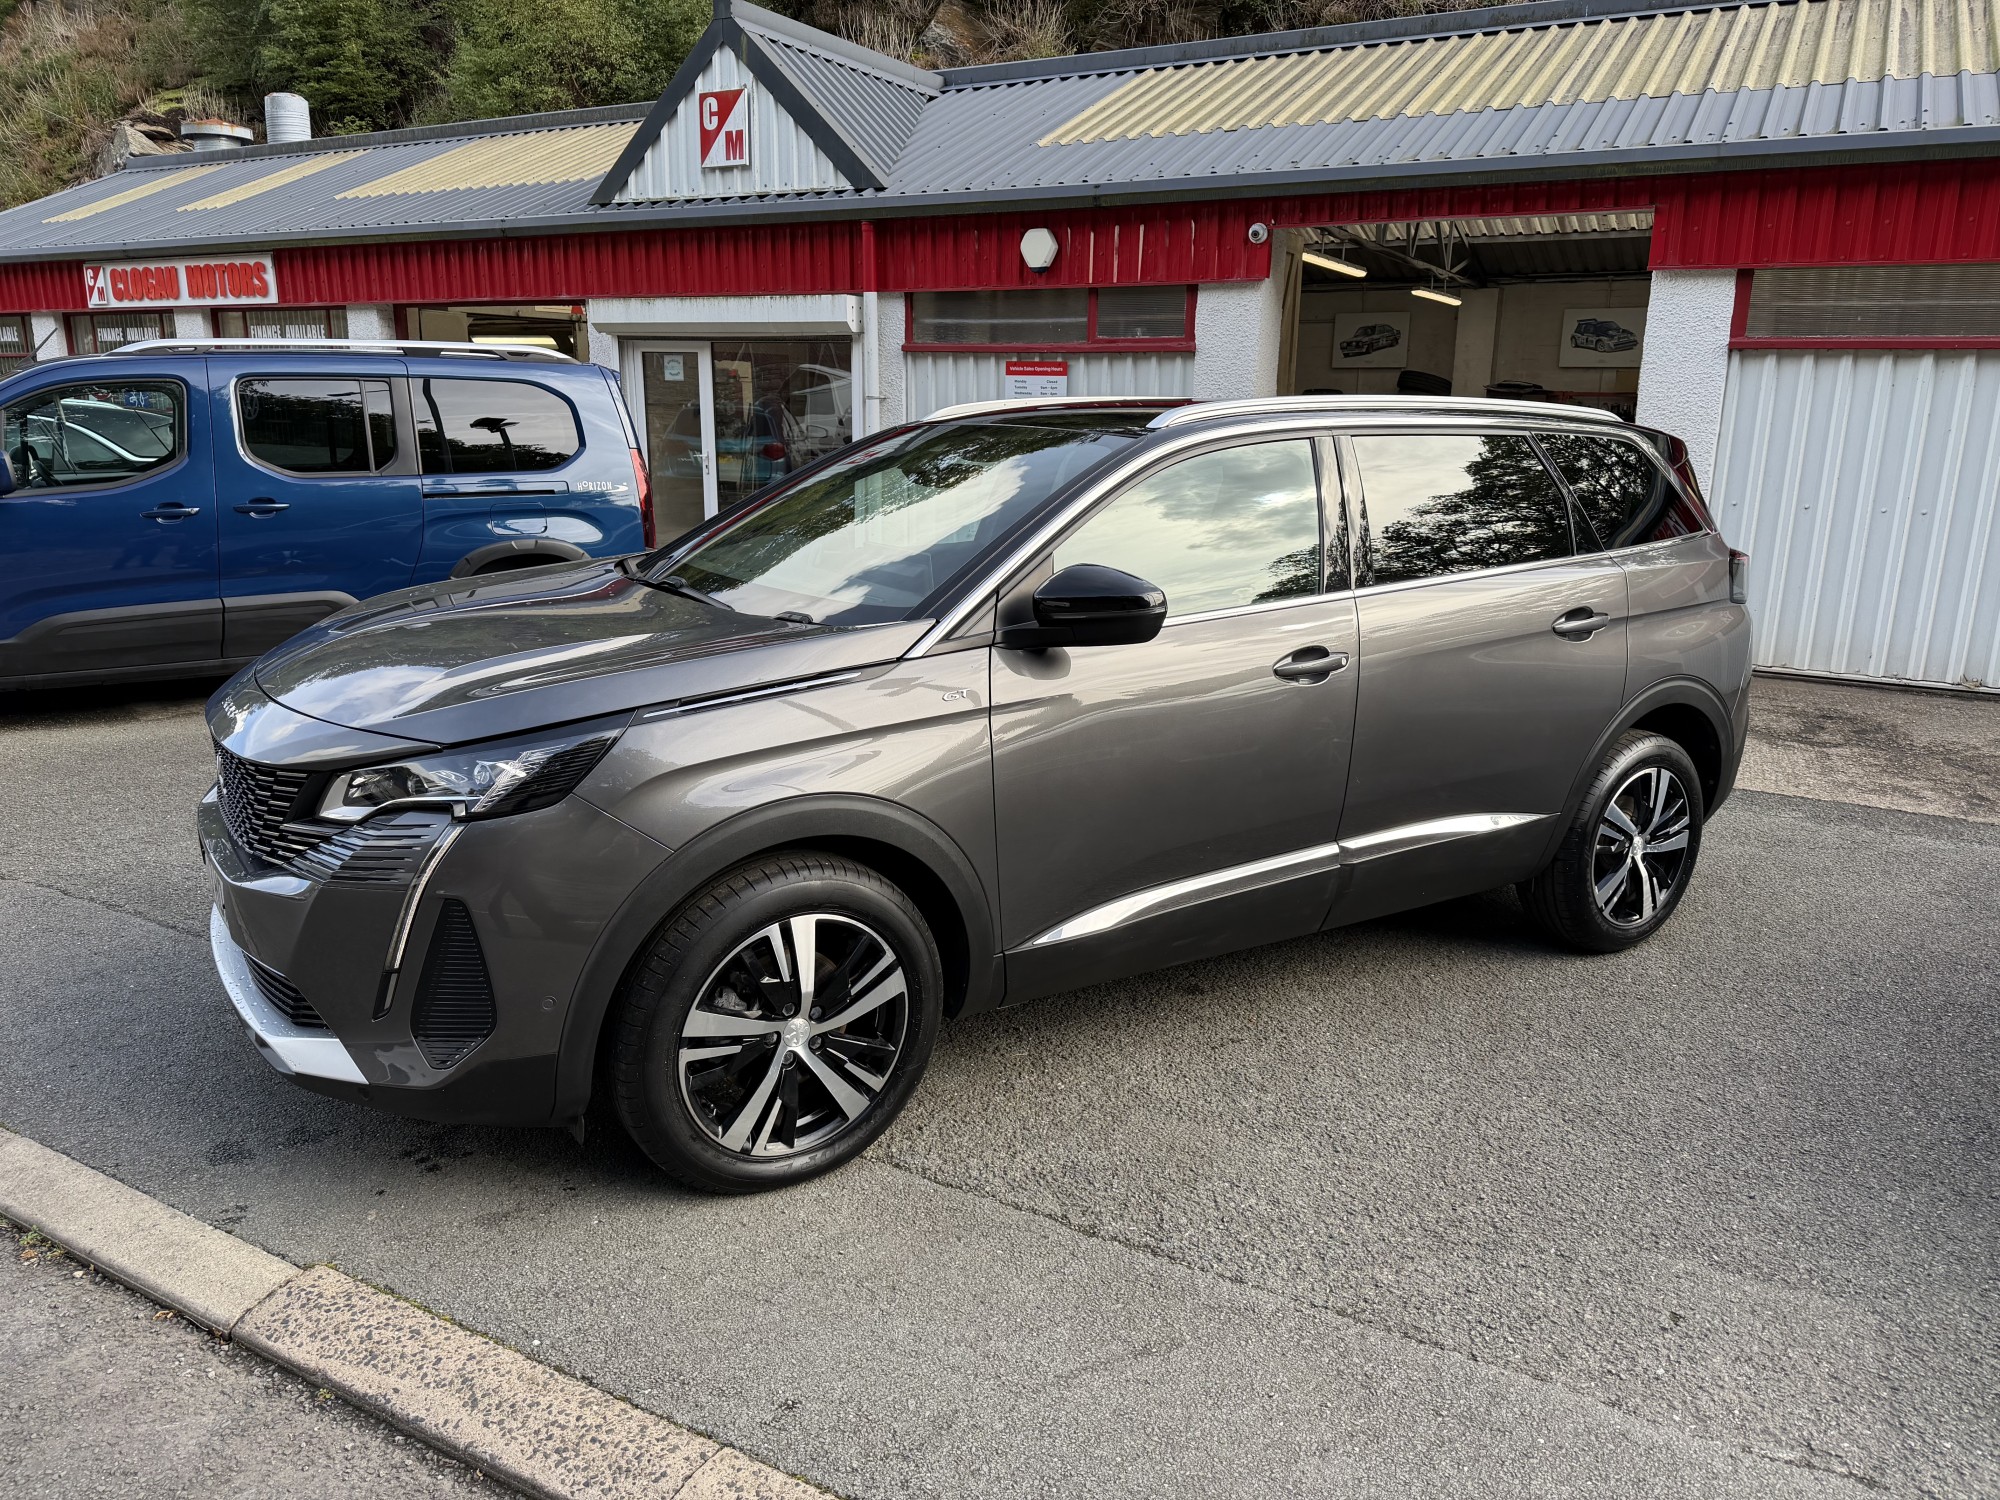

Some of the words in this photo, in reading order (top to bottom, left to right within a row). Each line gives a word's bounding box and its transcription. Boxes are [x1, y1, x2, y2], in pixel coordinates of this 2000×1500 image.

[703, 97, 718, 130] C
[725, 129, 744, 161] M
[109, 265, 180, 302] CLOGAU
[185, 261, 269, 299] MOTORS
[97, 327, 124, 342] FINANCE
[126, 326, 160, 342] AVAILABLE
[250, 324, 282, 339] FINANCE
[285, 324, 326, 339] AVAILABLE
[577, 480, 612, 491] HORIZON
[942, 688, 970, 701] GT
